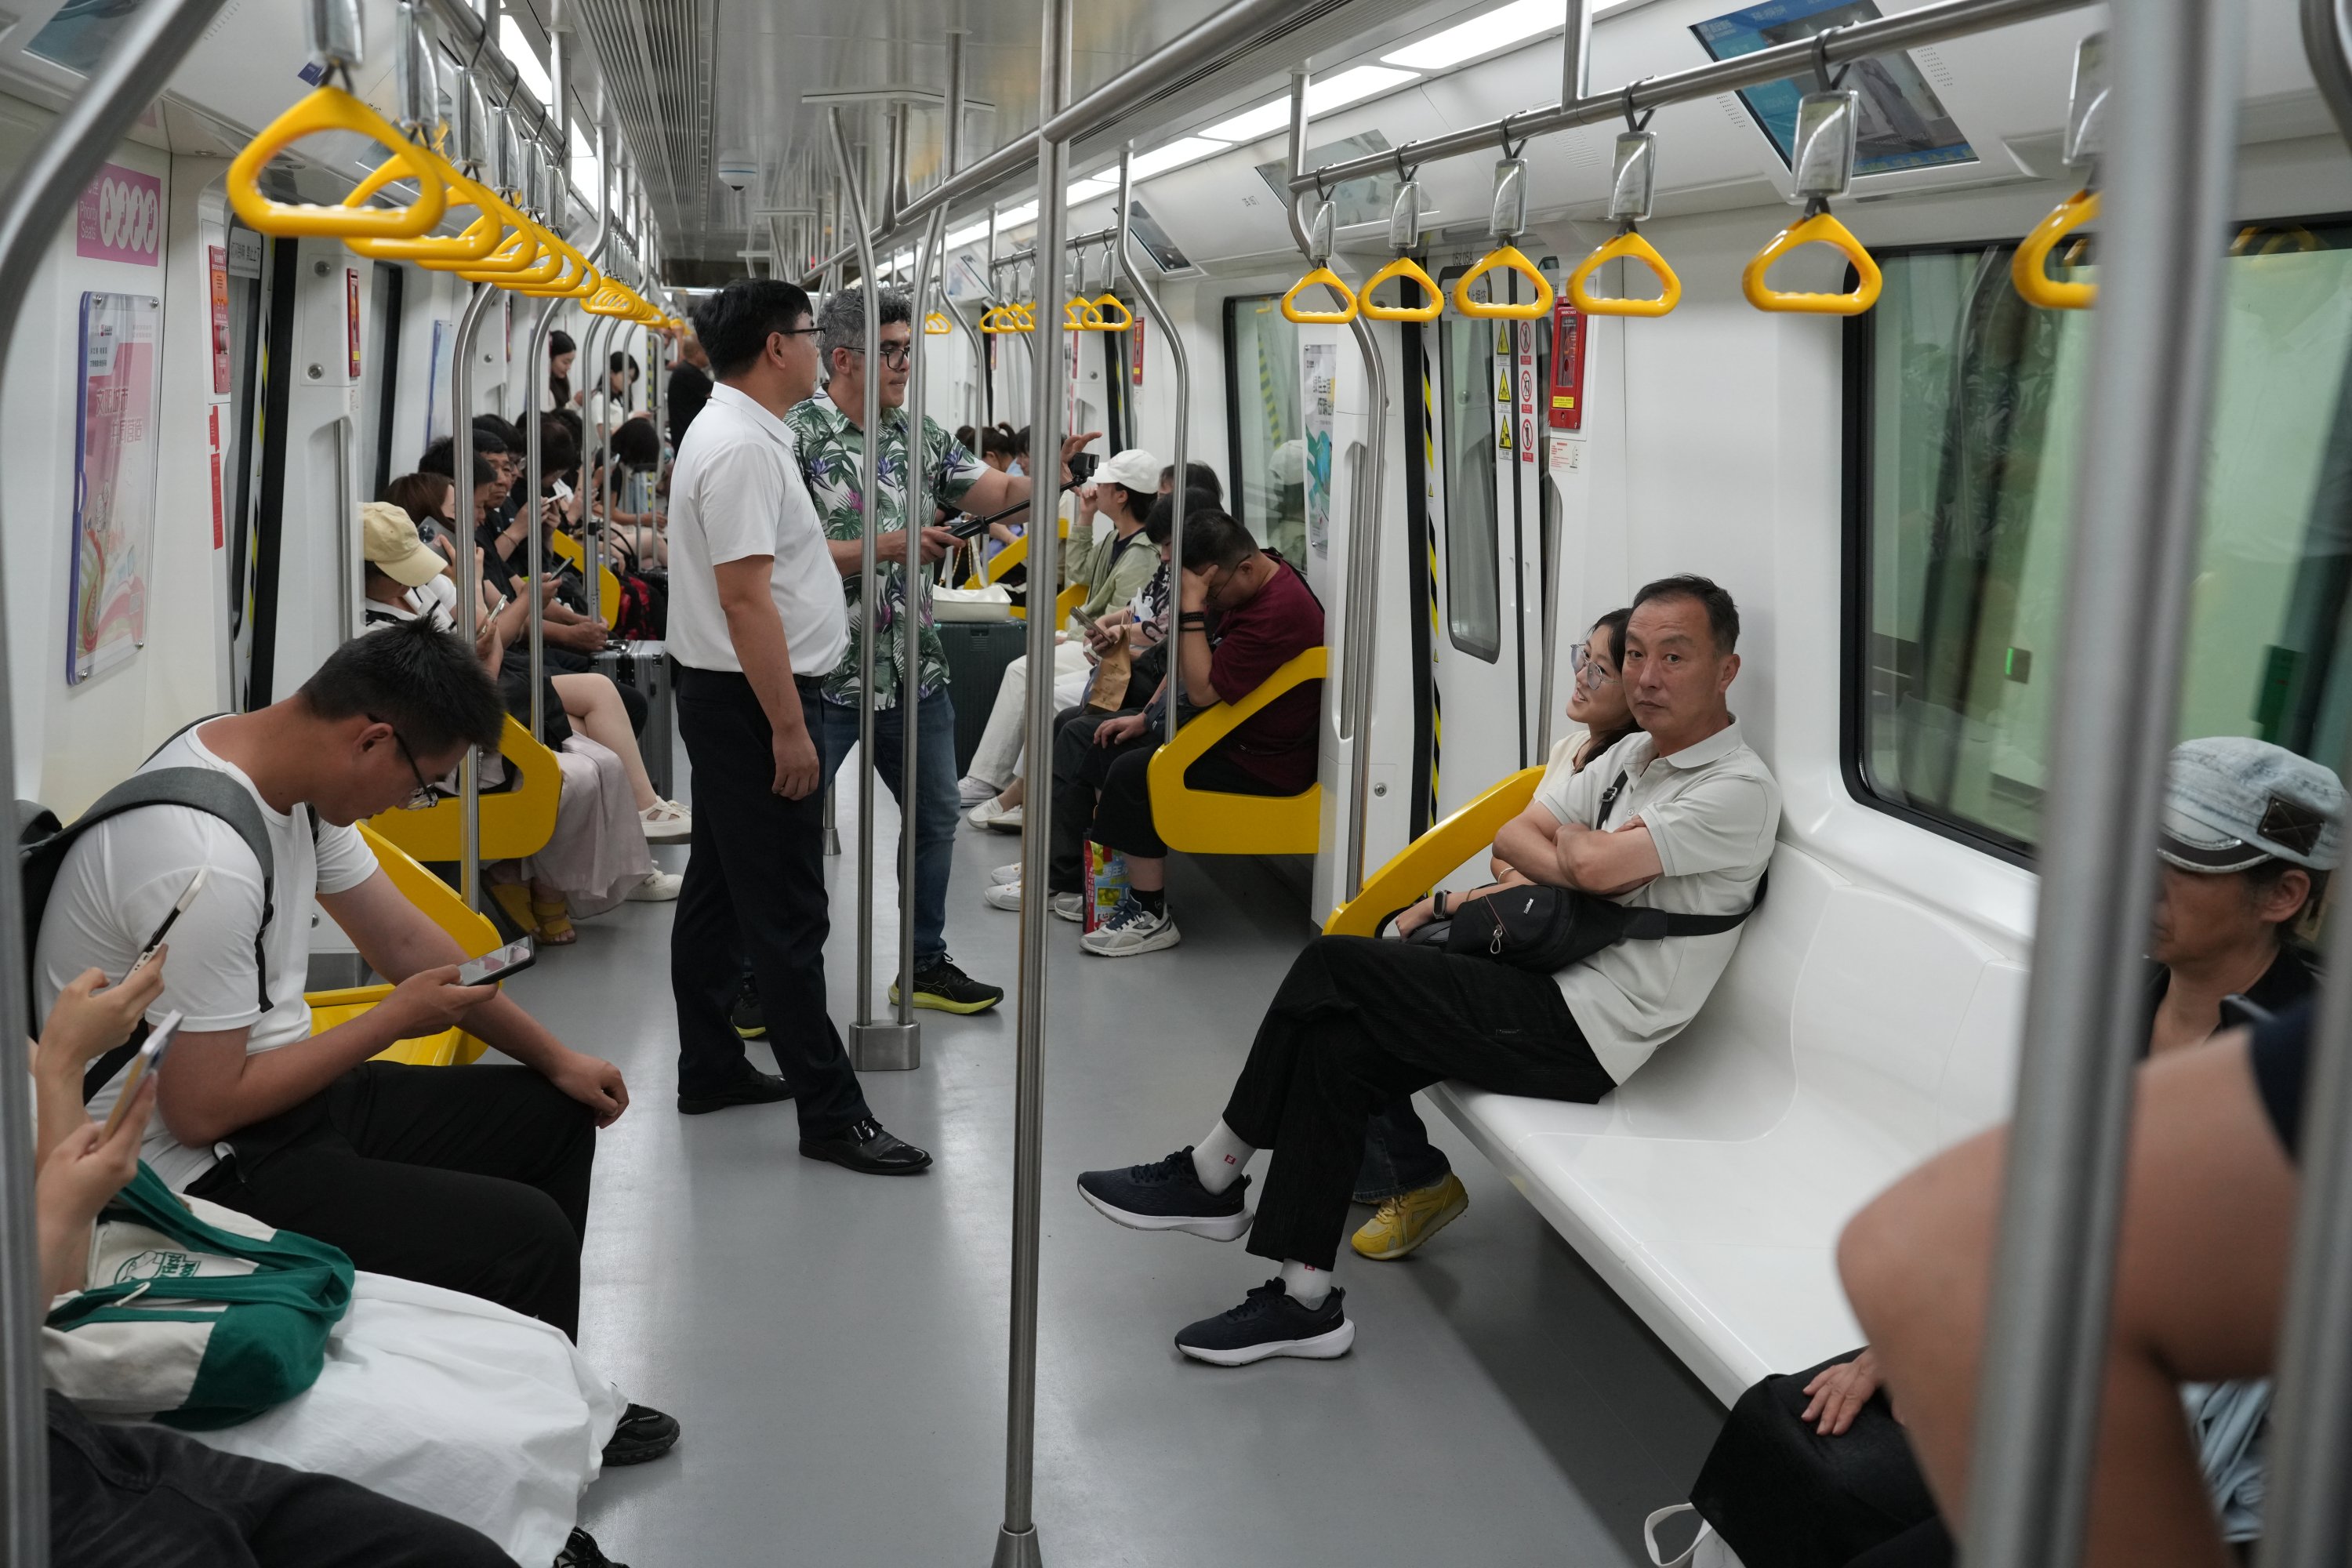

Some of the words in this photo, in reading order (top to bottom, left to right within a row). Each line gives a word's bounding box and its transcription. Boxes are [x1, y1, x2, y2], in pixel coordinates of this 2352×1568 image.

[80, 201, 98, 226] Priority
[81, 220, 96, 240] Seats
[96, 387, 129, 417] 文明城市
[111, 418, 143, 446] 共同营造
[162, 1254, 182, 1274] First
